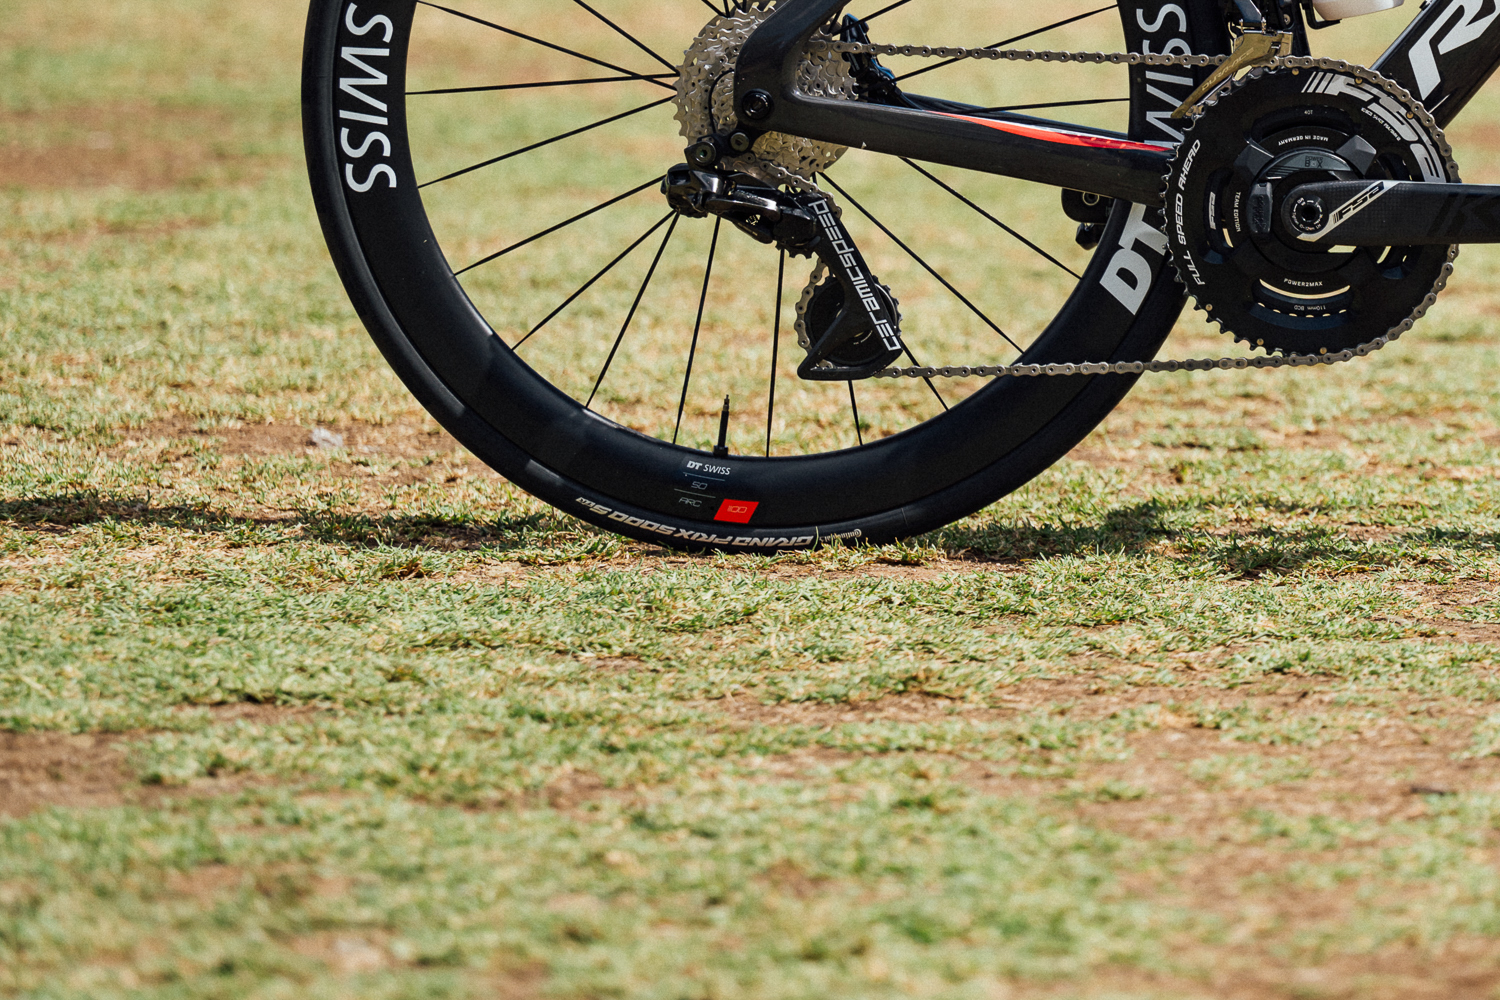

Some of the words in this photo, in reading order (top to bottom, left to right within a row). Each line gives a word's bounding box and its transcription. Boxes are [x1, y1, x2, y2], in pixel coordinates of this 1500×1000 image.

[338, 1, 398, 194] SWISS
[1278, 135, 1304, 146] GERMANY
[1312, 134, 1329, 142] MADE
[1177, 138, 1201, 191] AHEAD
[1233, 191, 1242, 209] TEAM
[1175, 192, 1187, 246] SPEED
[1233, 208, 1242, 233] EDITION
[1099, 201, 1170, 316] DT
[1183, 250, 1206, 286] FULL
[1283, 277, 1324, 287] POWER2MAX
[686, 460, 703, 470] DT
[703, 463, 732, 476] SWISS
[678, 496, 703, 508] ARC
[607, 510, 681, 536] 5000
[672, 527, 733, 545] PRIX
[732, 535, 815, 548] GRAND
